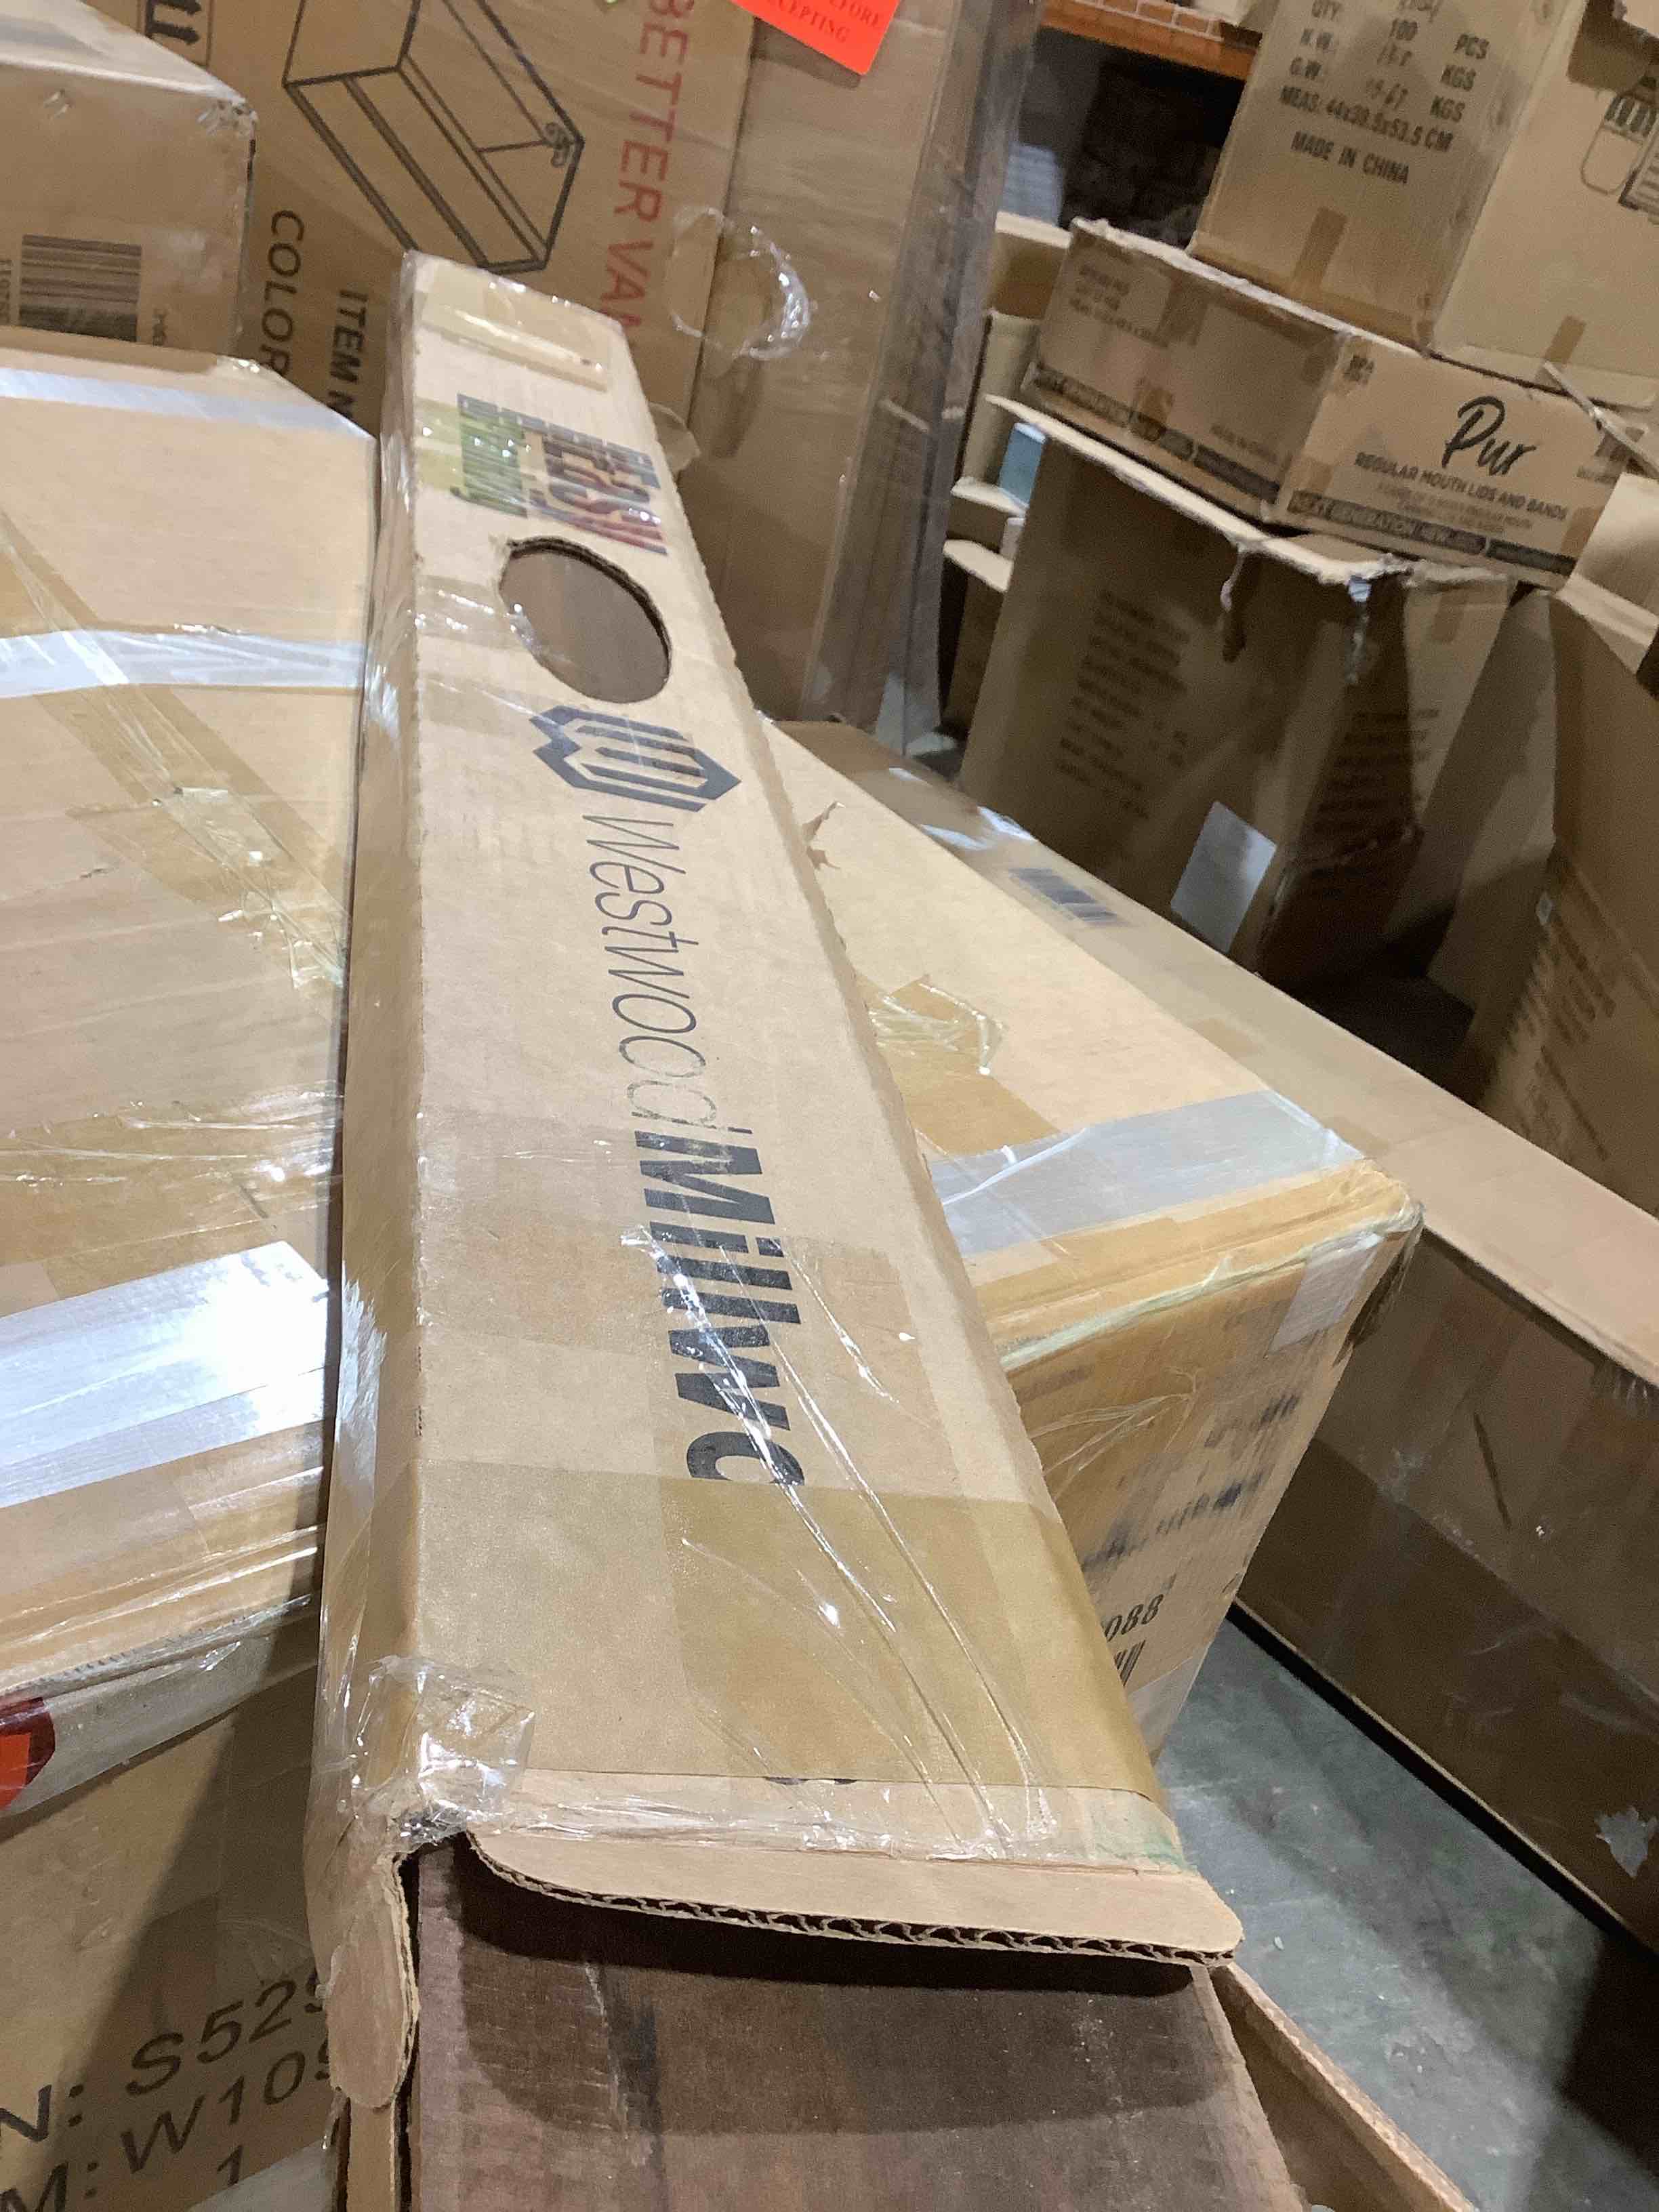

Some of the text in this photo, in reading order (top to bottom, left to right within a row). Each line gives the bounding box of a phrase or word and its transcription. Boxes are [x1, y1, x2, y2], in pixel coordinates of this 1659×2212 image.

[1454, 34, 1490, 60] PCS
[1440, 65, 1476, 91] KGS
[1430, 96, 1465, 123] KGS
[1291, 131, 1409, 184] MADE IN CHINA
[1425, 127, 1454, 152] CM
[329, 289, 368, 384] ITEM
[1441, 396, 1537, 476] Pur
[1355, 451, 1418, 480] REGULAR
[1420, 470, 1467, 494] MOUTH
[1468, 483, 1496, 501] LIDS
[1497, 490, 1527, 510] AND
[1527, 497, 1568, 521] BANDS
